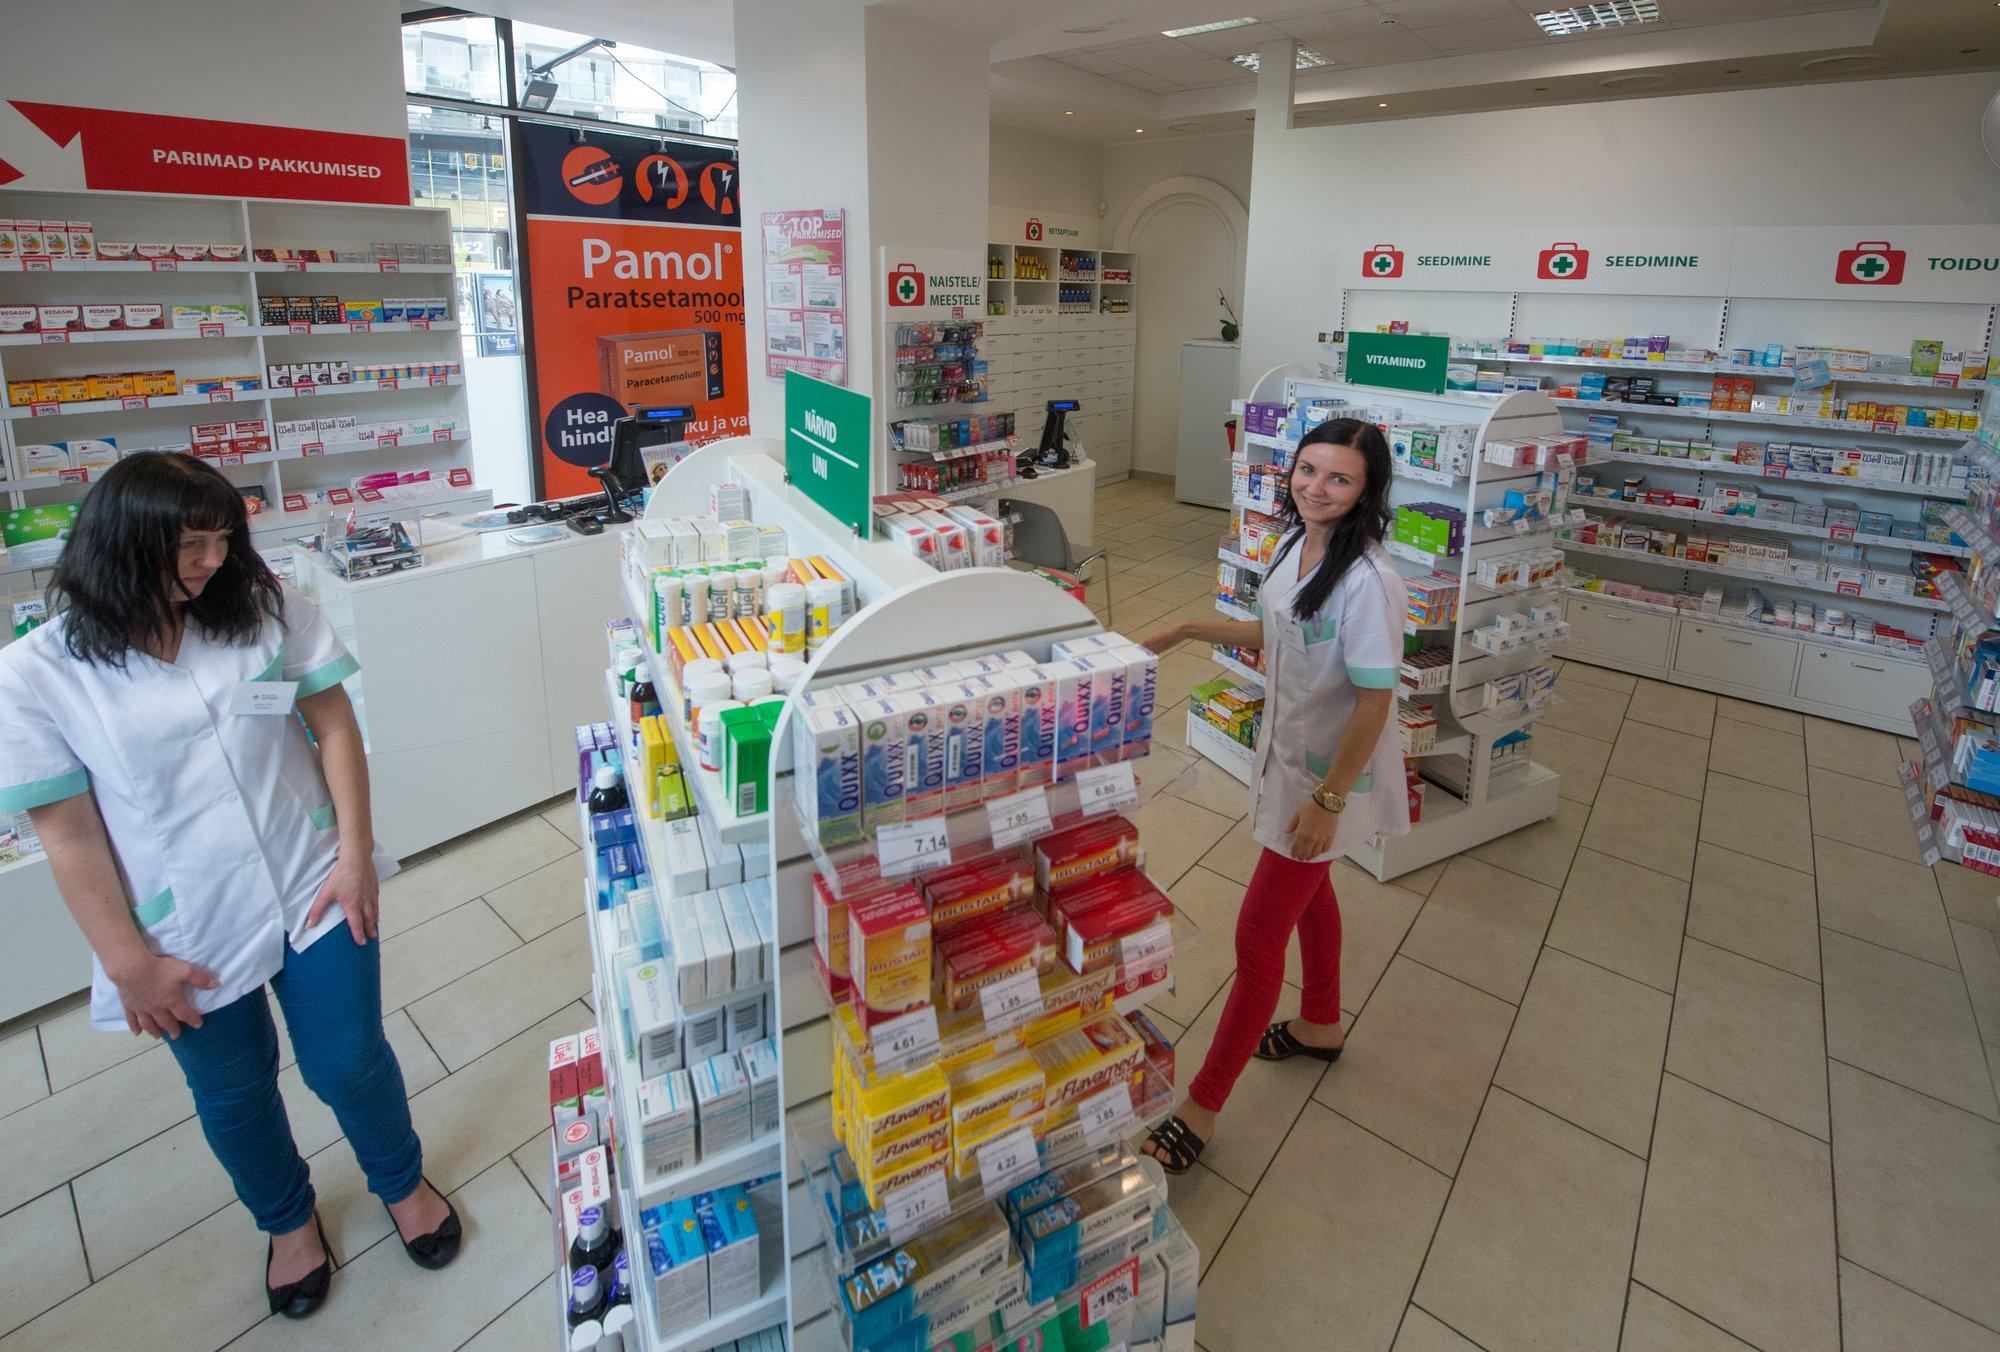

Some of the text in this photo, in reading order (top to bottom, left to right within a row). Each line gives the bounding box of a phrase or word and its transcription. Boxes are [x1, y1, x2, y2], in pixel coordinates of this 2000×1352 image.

[152, 148, 382, 179] PARIMAD PAKKUMISED
[791, 216, 823, 232] TOP
[1048, 228, 1079, 237] RETSEPTUUR
[1417, 256, 1491, 267] SEEDIMINE
[1605, 256, 1699, 268] SEEDIMINE
[1928, 257, 2000, 271] TOIDU
[930, 294, 980, 306] MEESTELE
[694, 310, 745, 326] 500 mg
[623, 345, 673, 364] Pamol
[1366, 354, 1426, 369] VITAMIINID
[627, 370, 701, 389] Paracetamolum
[566, 408, 609, 426] Hea
[712, 416, 727, 434] ja
[561, 427, 616, 449] hind!
[812, 452, 828, 480] UNI
[1006, 812, 1028, 827] 7.95
[915, 834, 948, 853] 7.14
[1054, 855, 1111, 880] IBUSTAR
[938, 893, 1002, 920] IBUSTAR
[893, 1035, 916, 1053] 4.61
[1061, 1050, 1138, 1101] Flavamed
[884, 1092, 947, 1130] Flavamed
[886, 1123, 948, 1161] Flavamed
[887, 1154, 948, 1190] Flavamed
[998, 1155, 1017, 1171] 4.22
[905, 1200, 926, 1218] 2.17
